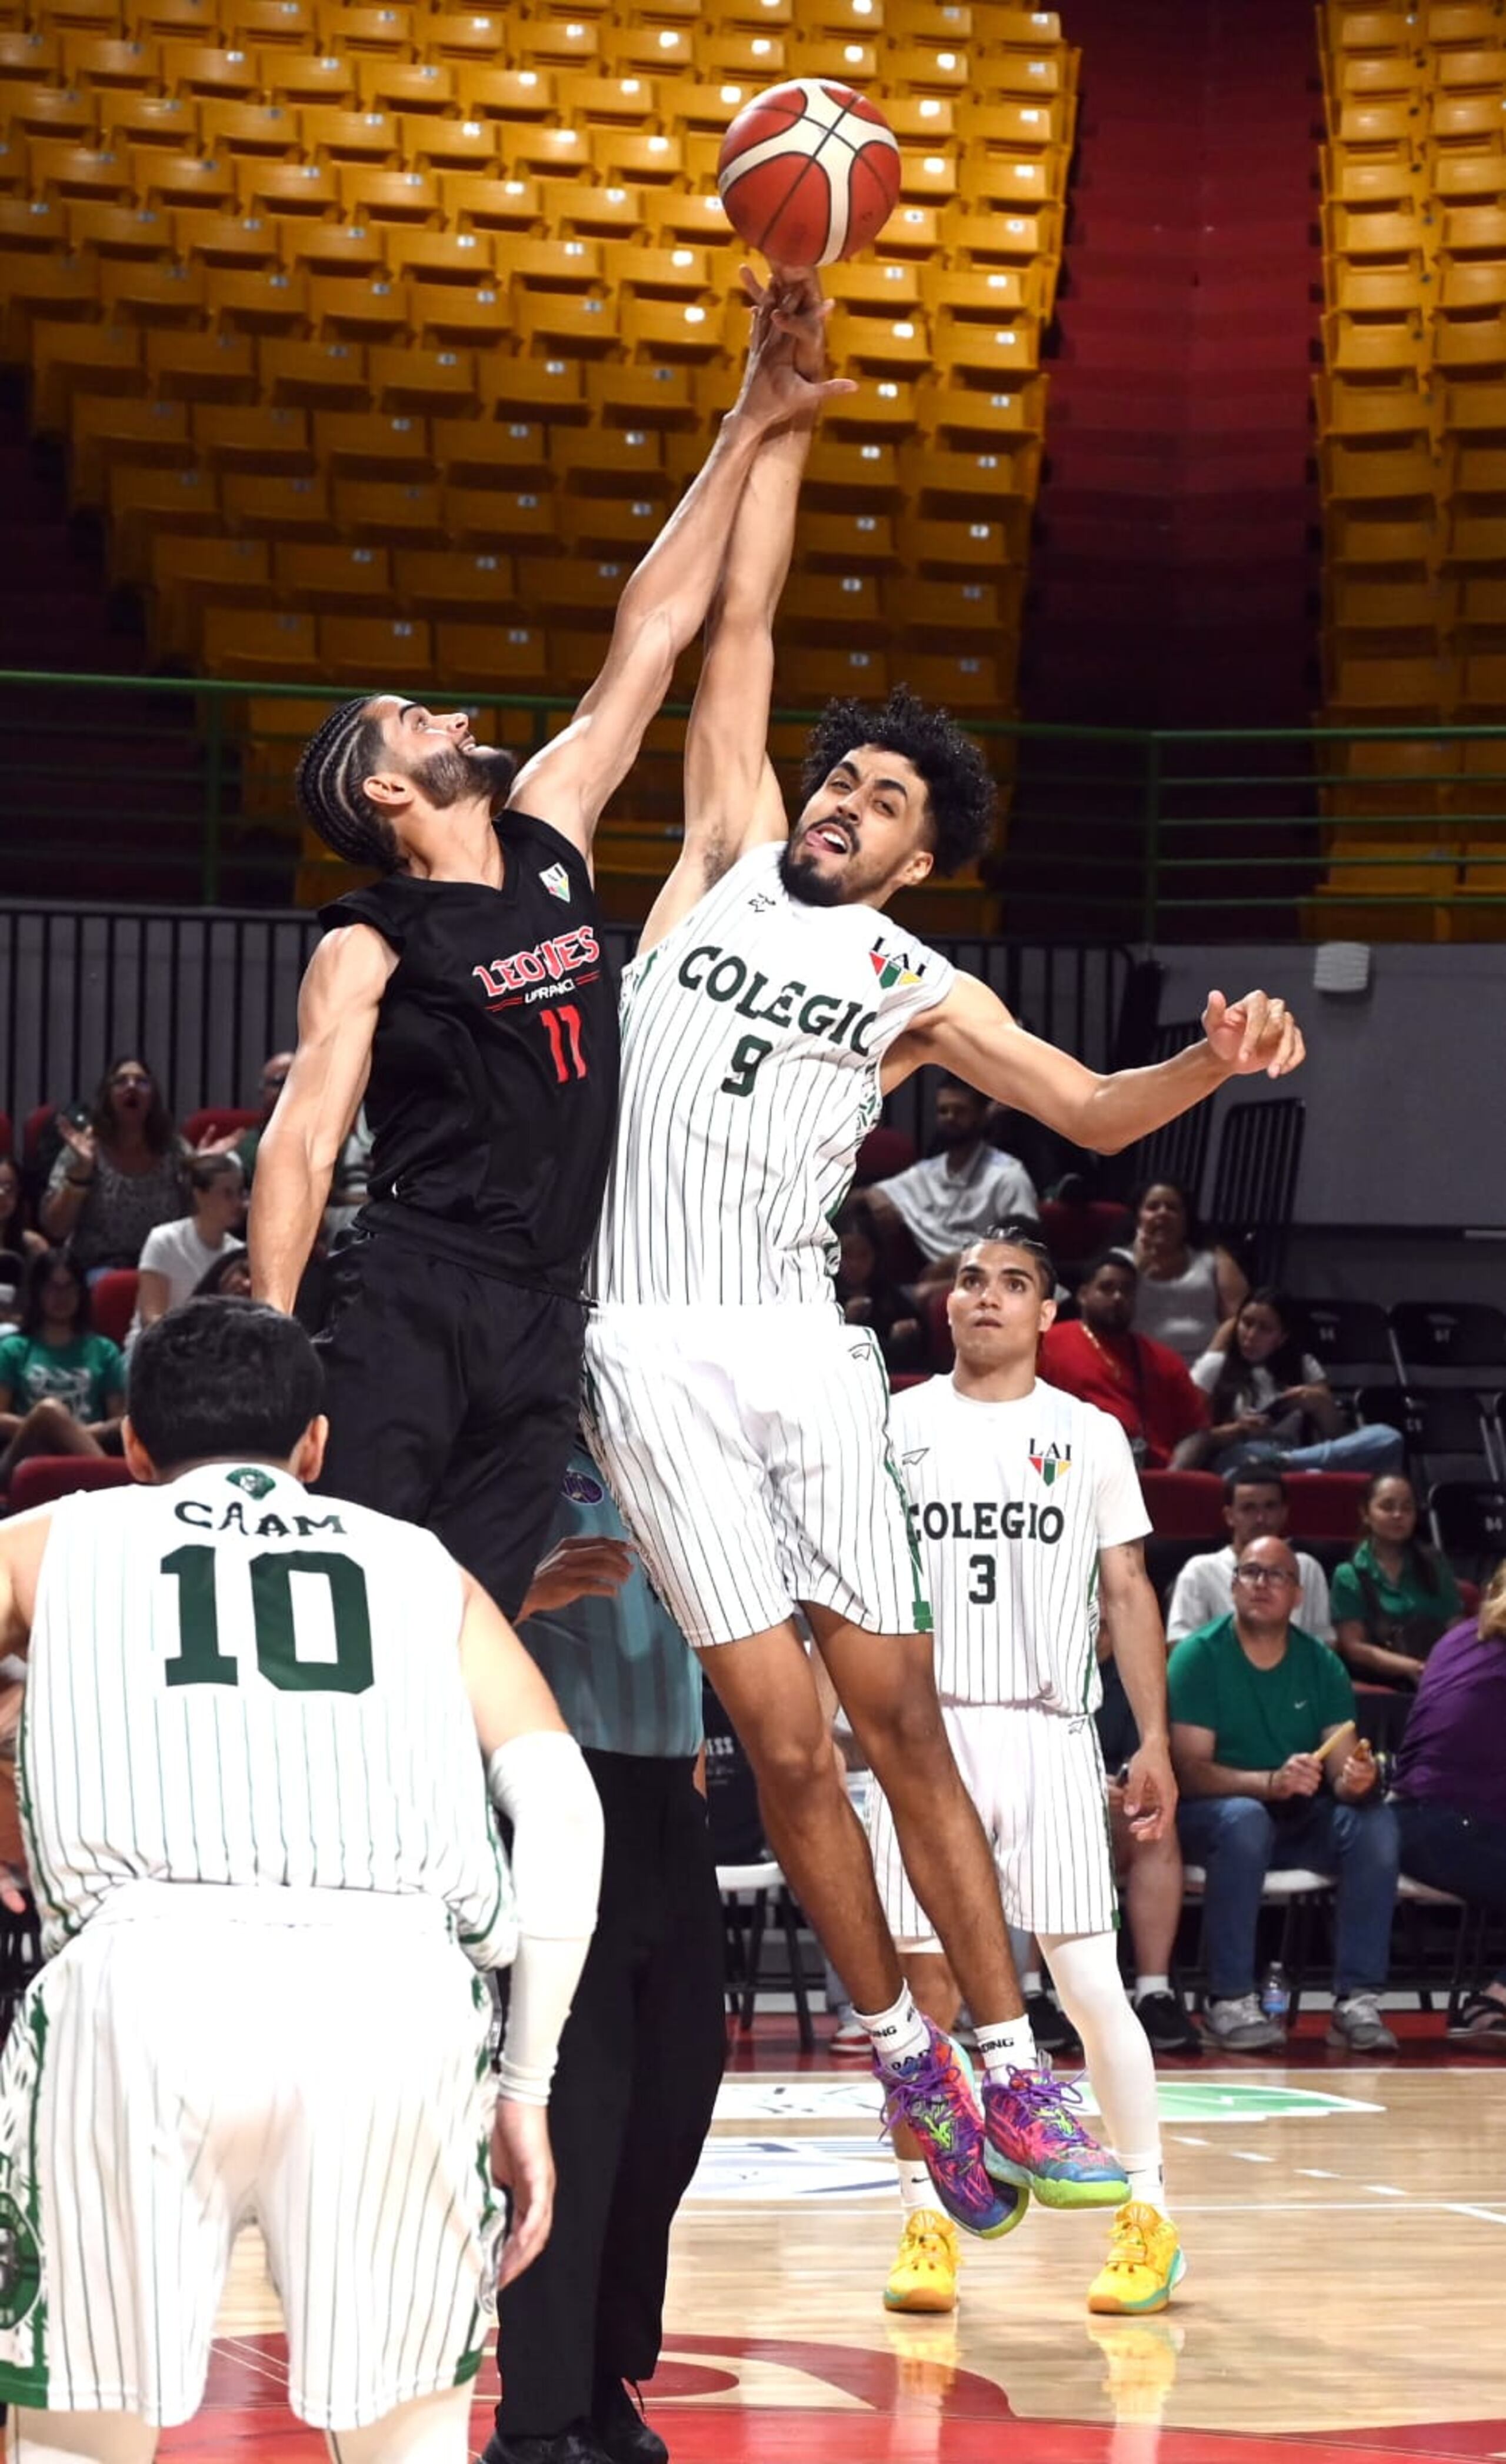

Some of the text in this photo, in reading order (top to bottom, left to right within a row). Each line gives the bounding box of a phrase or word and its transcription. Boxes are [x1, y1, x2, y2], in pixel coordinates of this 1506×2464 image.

[539, 1004, 587, 1083] 11
[721, 1034, 773, 1097] 9
[174, 1501, 347, 1537] CAAM
[969, 1554, 996, 1604] 3
[160, 1544, 374, 1695] 10
